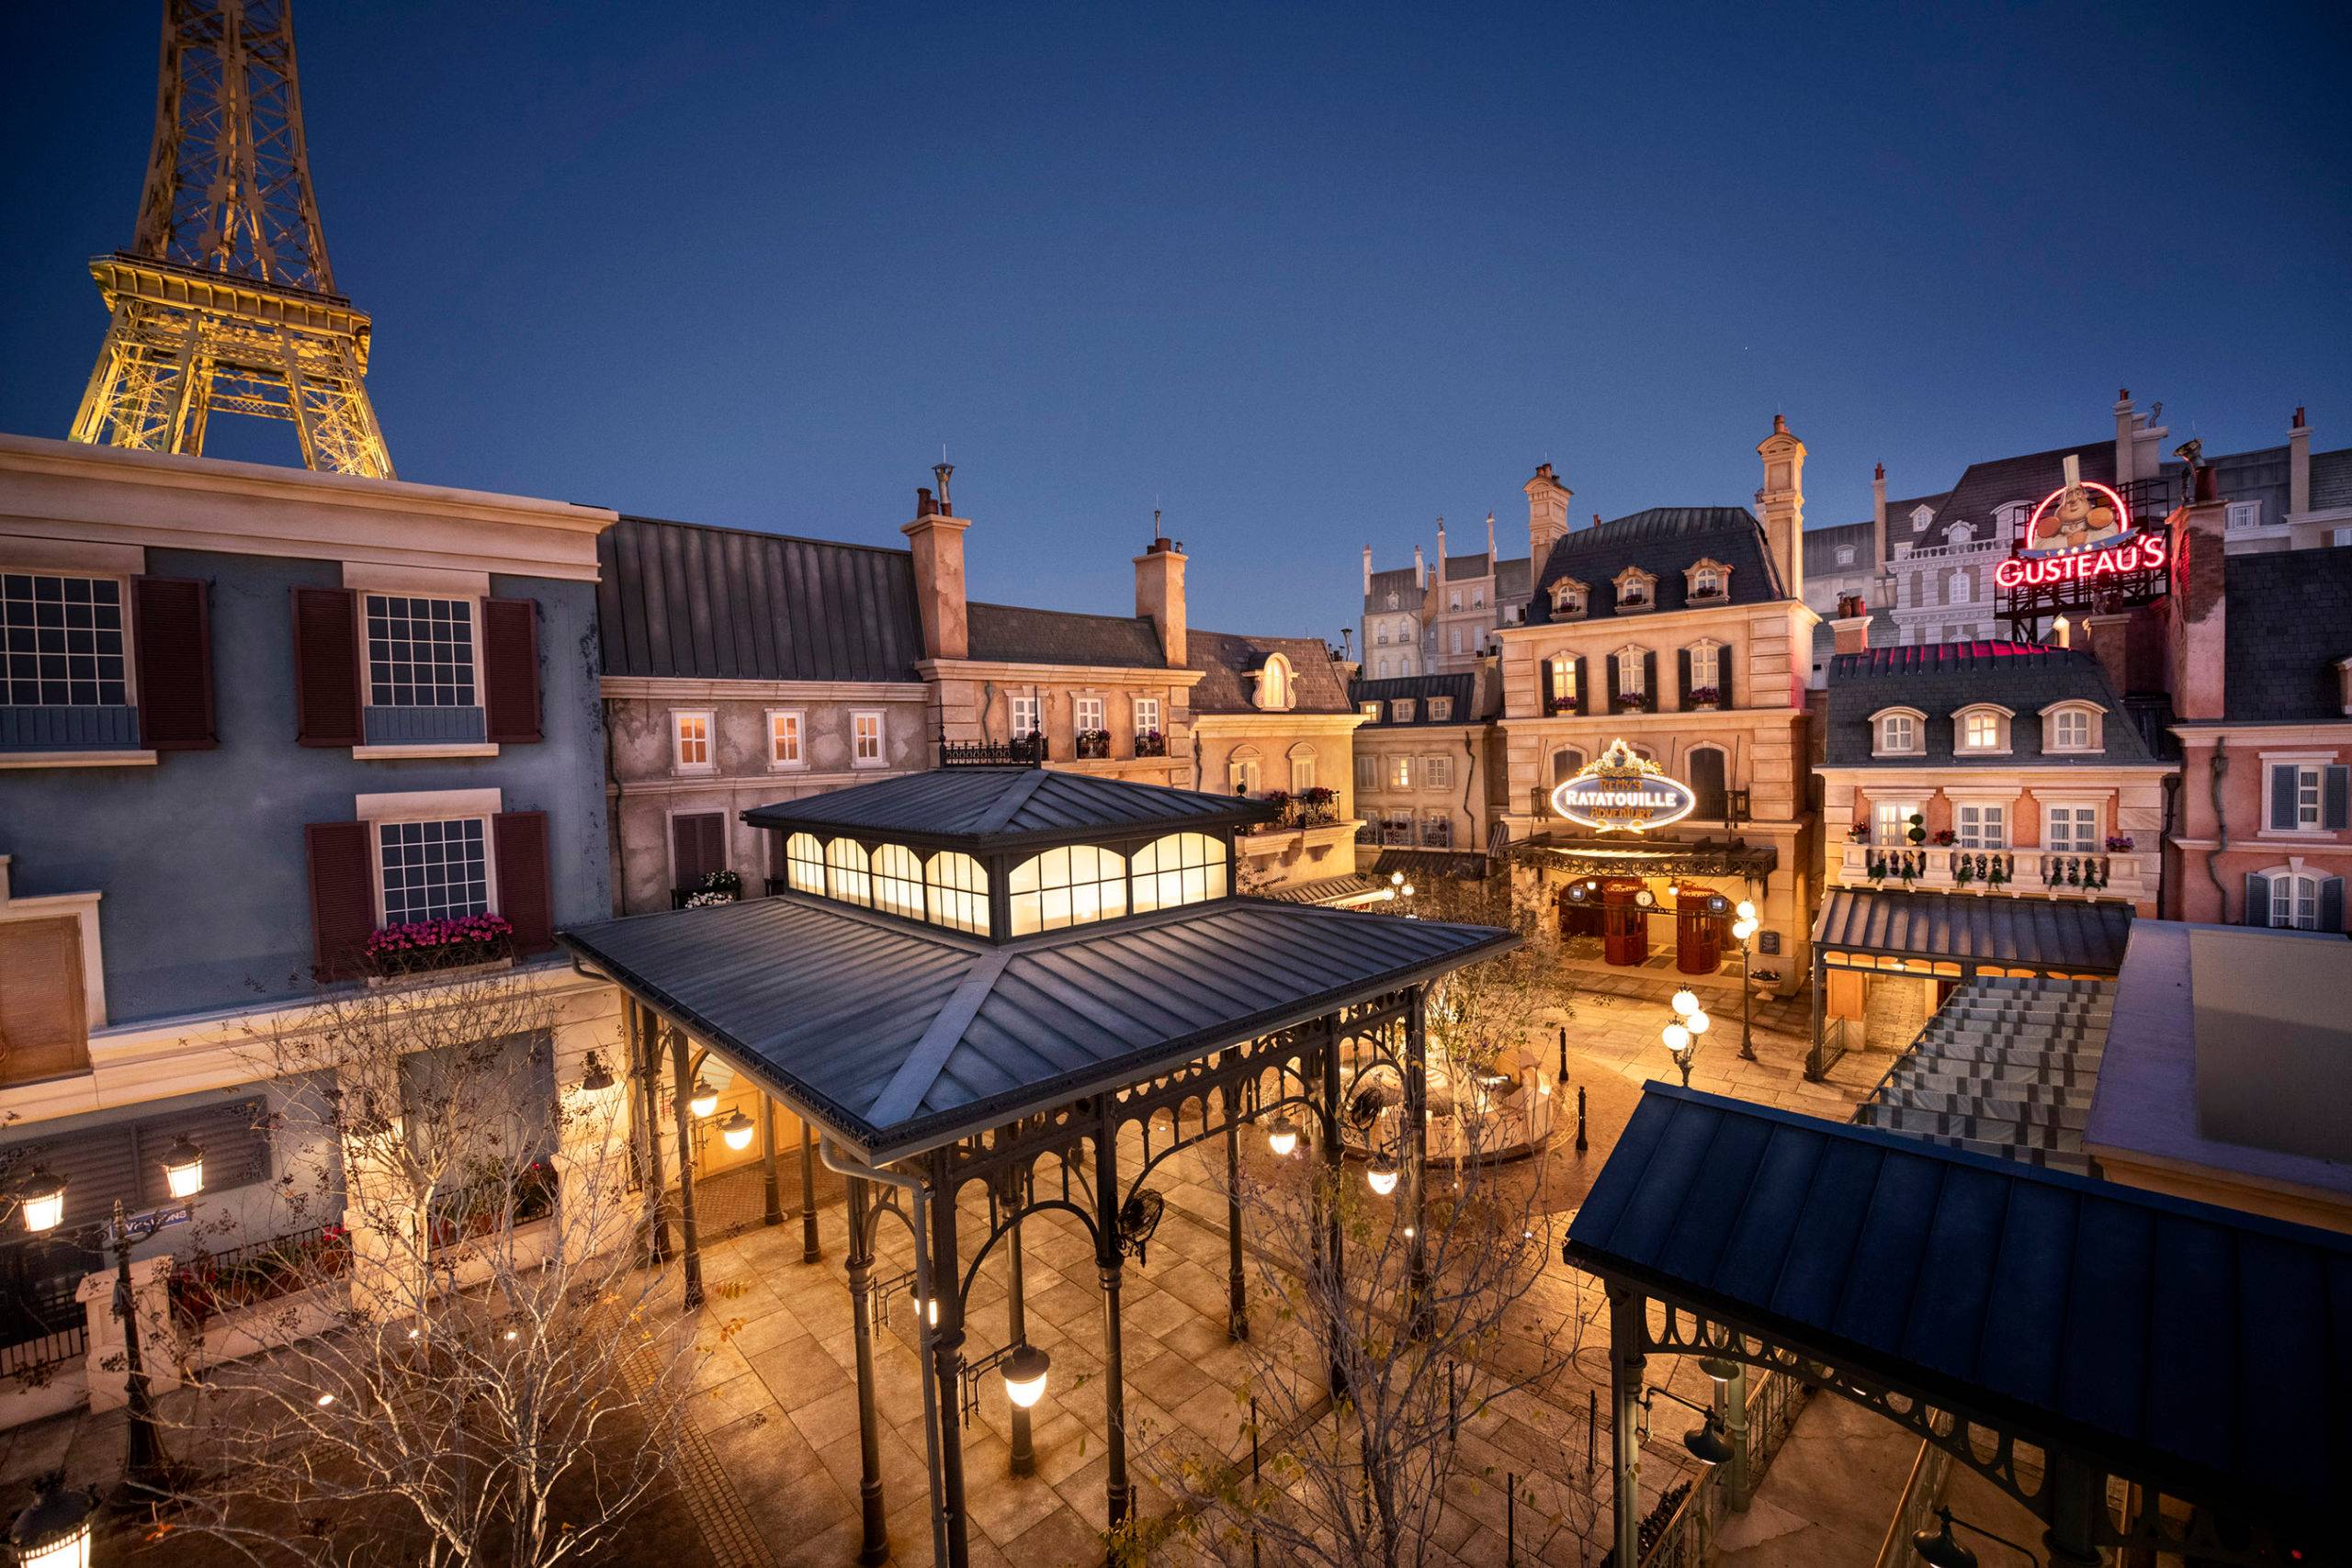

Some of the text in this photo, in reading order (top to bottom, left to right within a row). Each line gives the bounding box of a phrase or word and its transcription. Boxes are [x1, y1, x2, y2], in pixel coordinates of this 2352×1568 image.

[1996, 536, 2165, 587] GUSTEAU'S
[1600, 779, 1643, 791] REMY'S
[1566, 791, 1677, 807] RATATOUILLE
[1589, 808, 1654, 819] ADVENTURE
